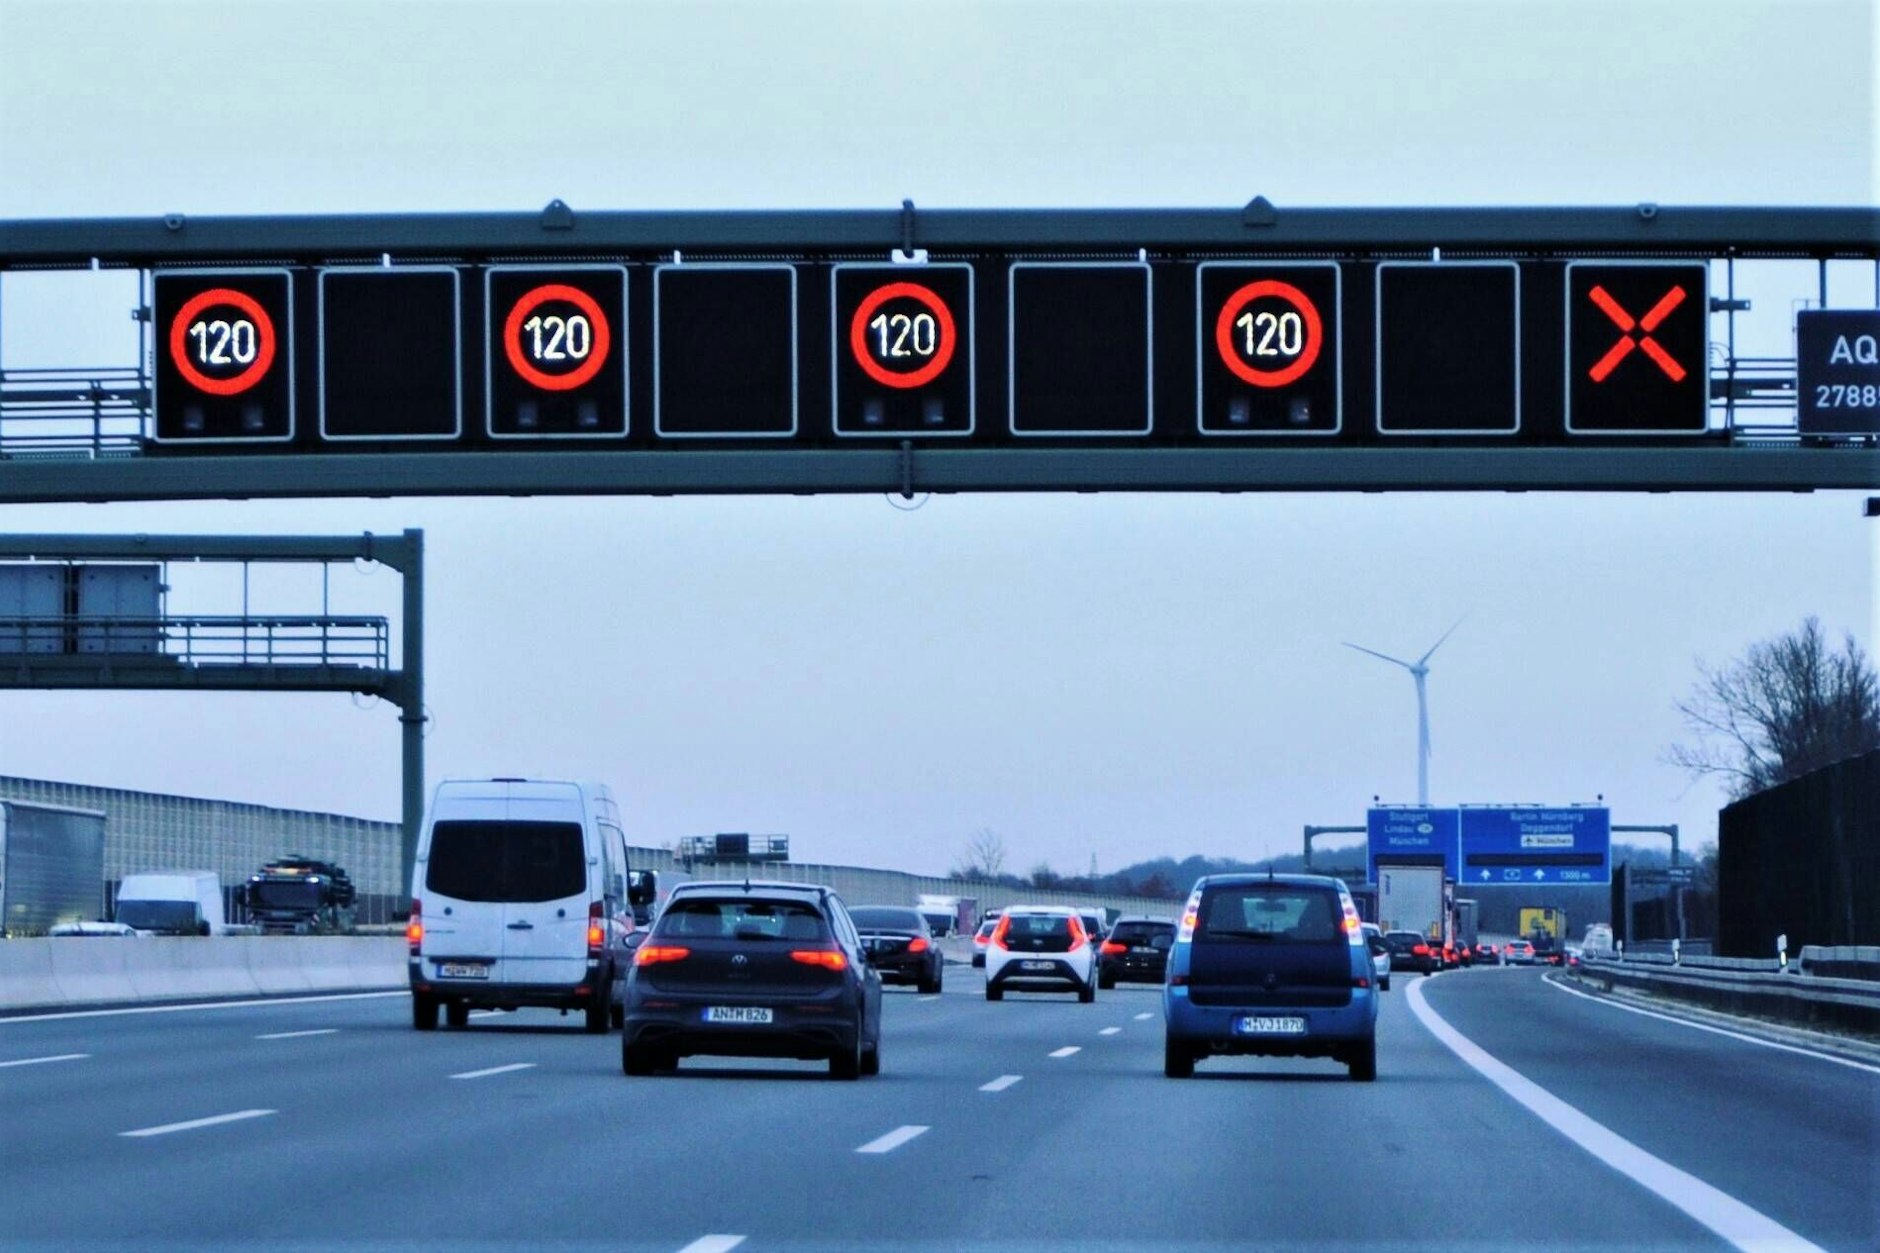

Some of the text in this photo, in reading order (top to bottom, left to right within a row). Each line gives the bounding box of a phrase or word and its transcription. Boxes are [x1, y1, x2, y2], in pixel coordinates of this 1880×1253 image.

[189, 319, 257, 365] 120
[523, 315, 590, 360] 120
[870, 313, 936, 357] 120
[1236, 311, 1302, 356] 120
[1829, 334, 1879, 365] AQ
[1816, 384, 1880, 408] 2788
